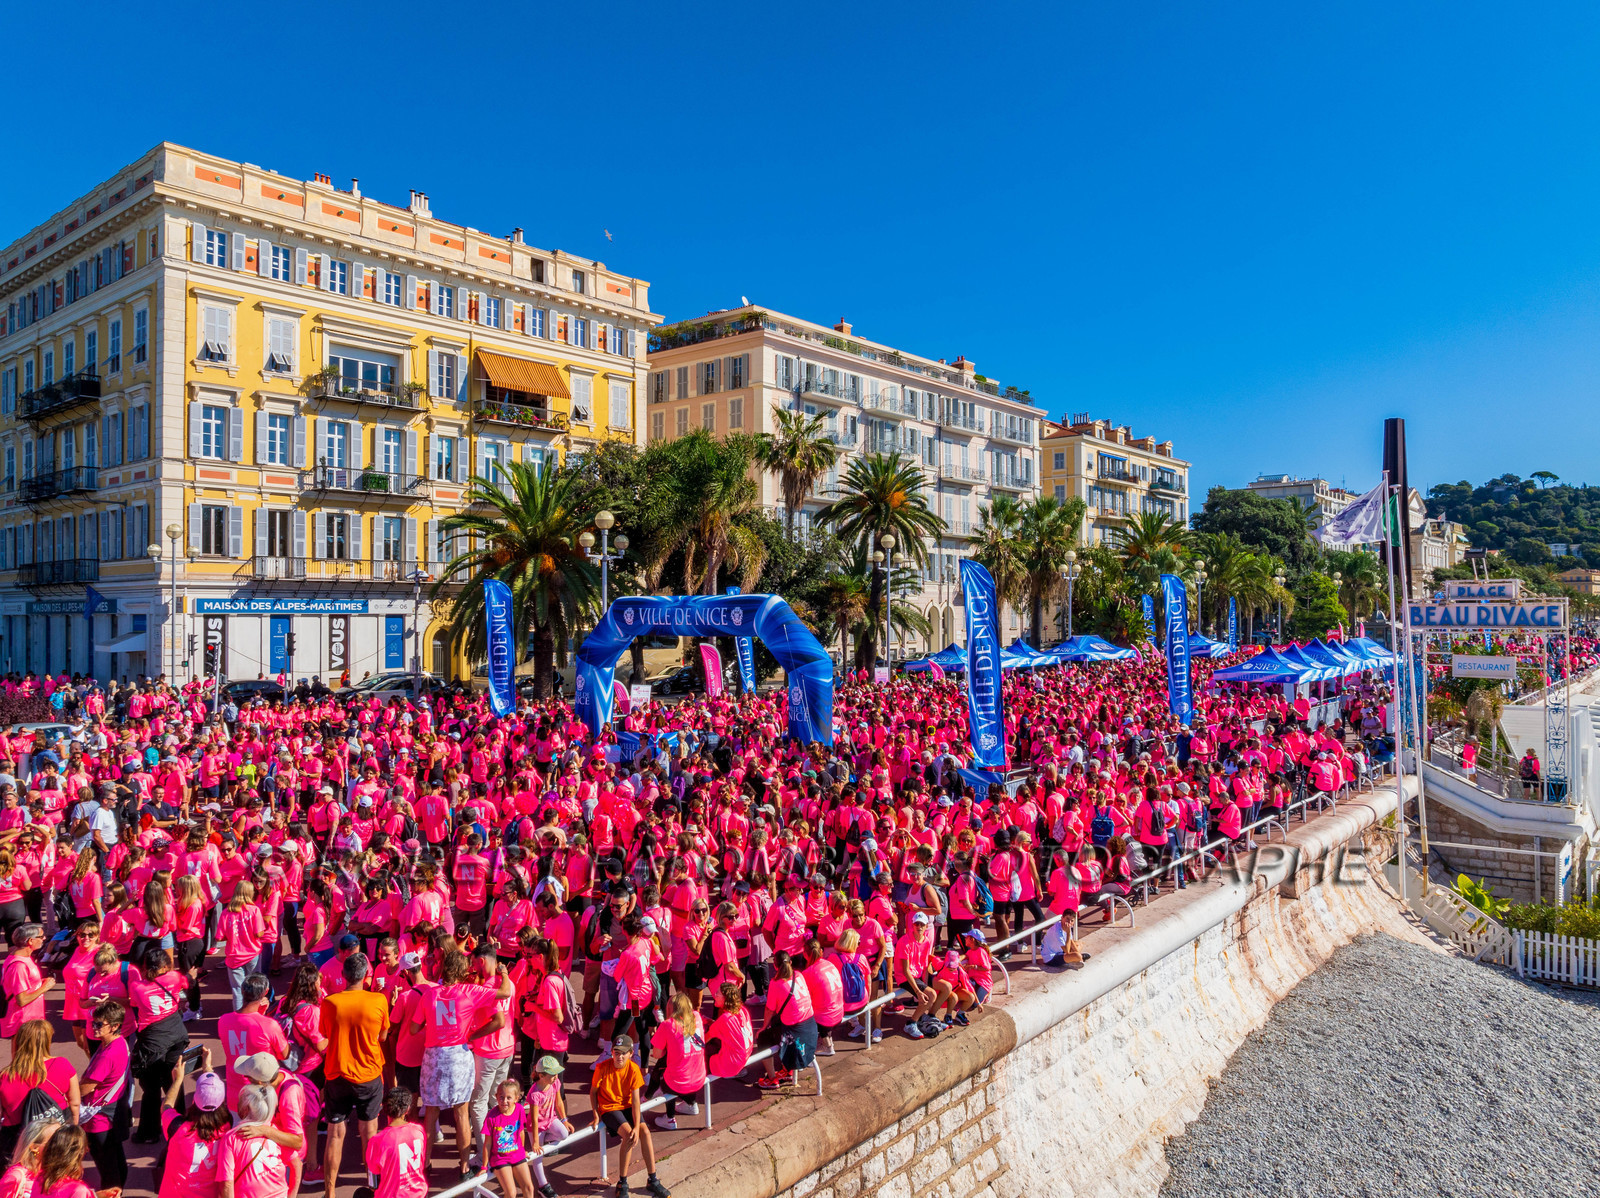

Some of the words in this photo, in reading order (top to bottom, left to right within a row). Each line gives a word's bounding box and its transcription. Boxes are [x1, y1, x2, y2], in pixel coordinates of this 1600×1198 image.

[203, 602, 248, 610] MAISON
[250, 602, 272, 610] DES
[273, 602, 363, 611] ALPES-MARITIMES
[491, 600, 506, 634] NICE
[639, 607, 672, 626] VILLE
[674, 607, 692, 626] DE
[695, 607, 728, 626] NICE
[970, 590, 991, 640] NICE
[1170, 595, 1184, 633] NICE
[1410, 606, 1469, 626] BEAU
[1477, 606, 1560, 626] RIVAGE
[331, 618, 345, 669] VOUS
[493, 637, 508, 656] DE
[740, 637, 749, 647] D
[1172, 635, 1185, 657] DE
[742, 649, 753, 679] VILLE
[975, 644, 994, 672] DE
[1457, 662, 1511, 672] RESTAURANT
[493, 659, 509, 696] VILLE
[1173, 660, 1188, 699] VILLE
[975, 676, 997, 730] VILLE
[436, 1000, 457, 1026] N
[228, 1030, 247, 1056] N
[398, 1138, 421, 1175] N
